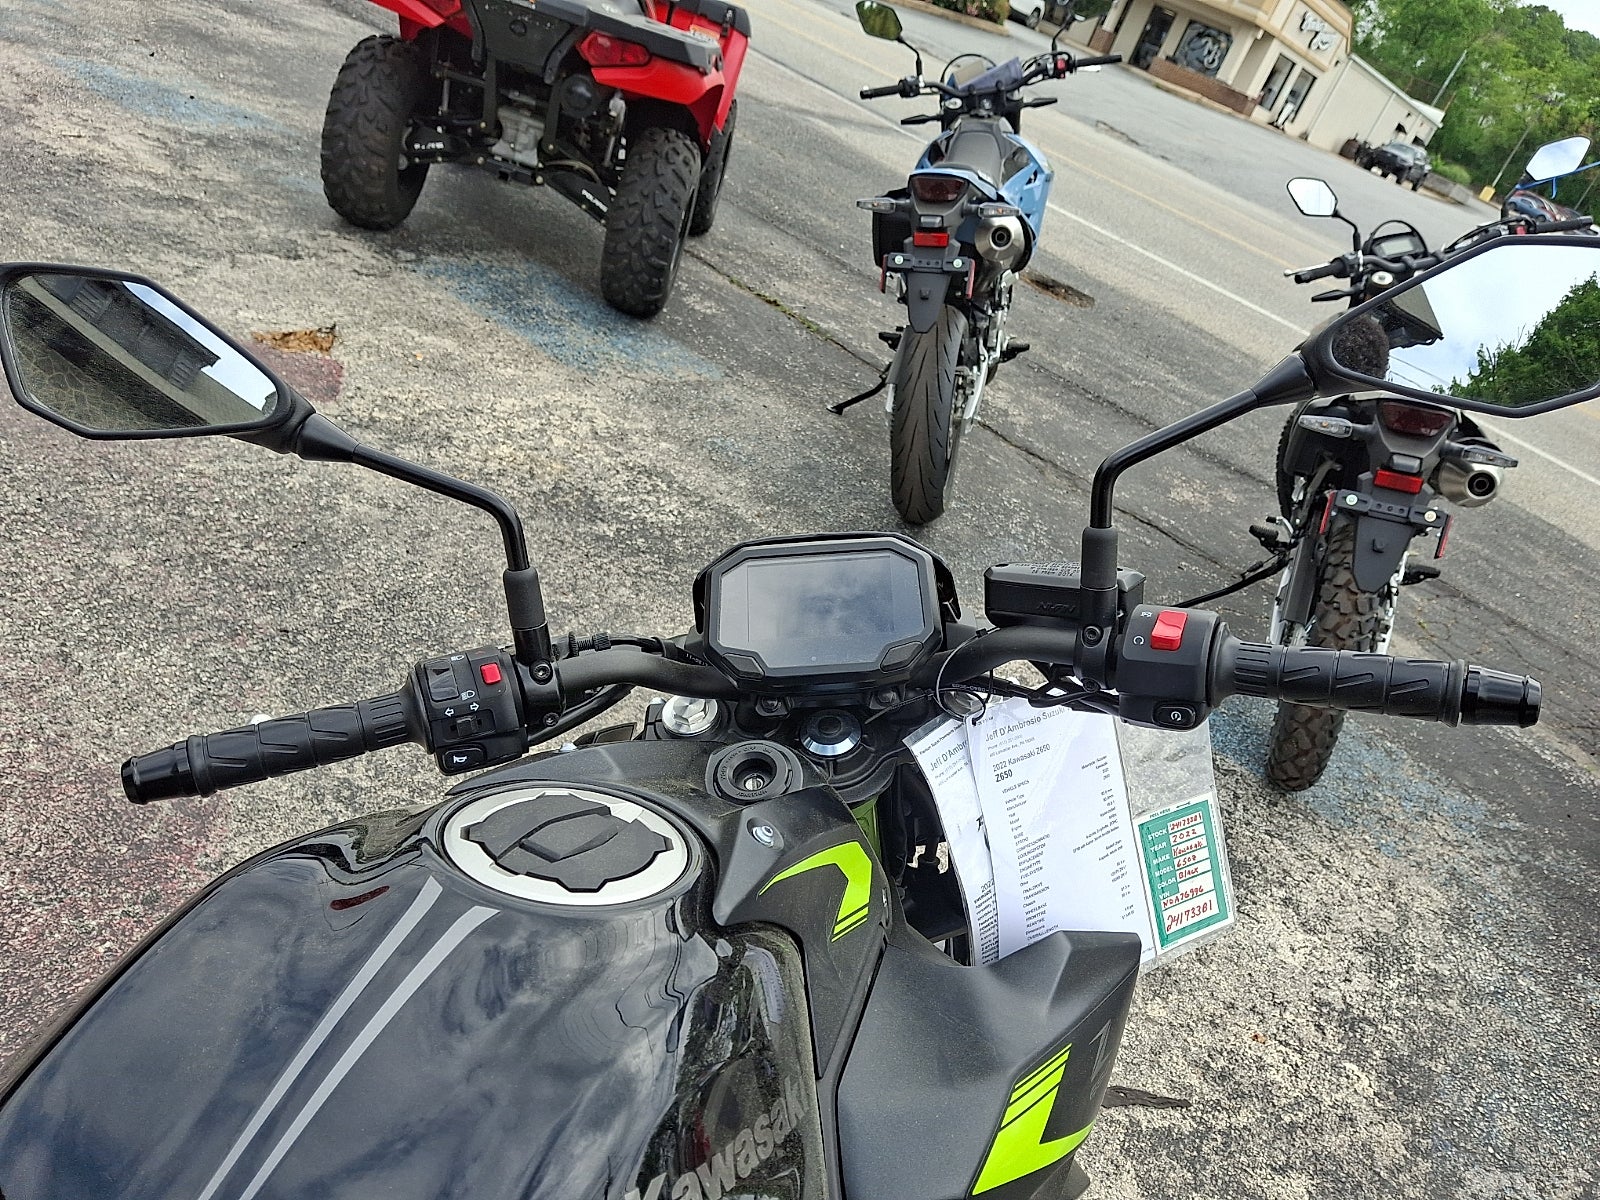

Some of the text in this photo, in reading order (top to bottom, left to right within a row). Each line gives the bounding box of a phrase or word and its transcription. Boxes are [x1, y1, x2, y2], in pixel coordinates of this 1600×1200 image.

[985, 729, 999, 742] Jeff
[999, 715, 1041, 737] D'Ambrosio
[1008, 749, 1036, 766] Kawasaki
[995, 768, 1013, 783] Z650
[1148, 828, 1168, 841] STOCK
[1171, 828, 1197, 843] 2022
[1150, 842, 1167, 853] YEAR
[1152, 853, 1171, 865] MAKE
[1154, 865, 1174, 877] MODEL
[1157, 877, 1177, 889] COLOR
[1158, 891, 1170, 900] VIN
